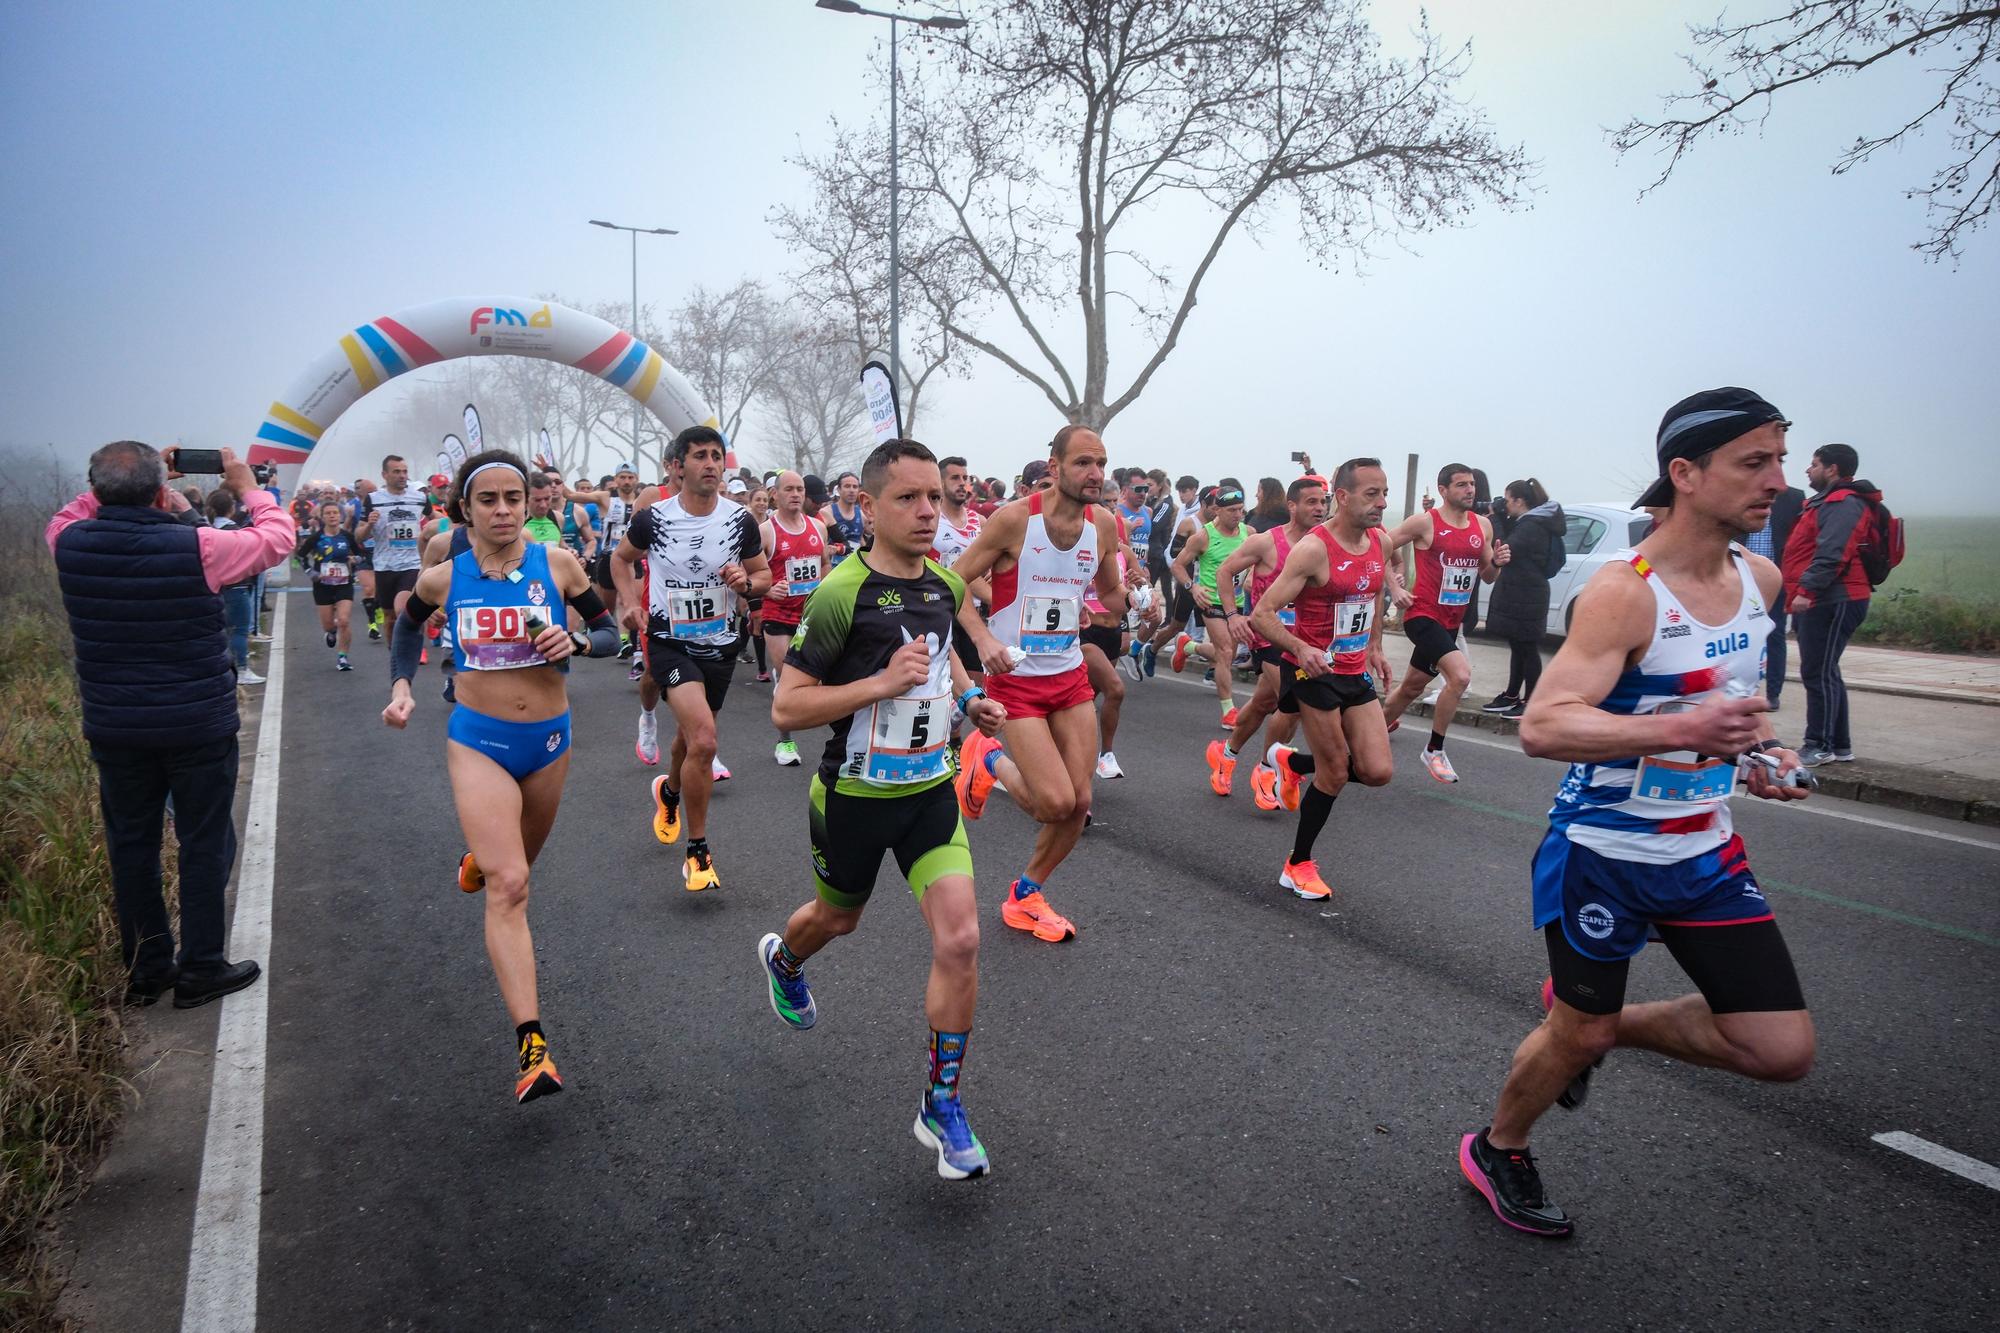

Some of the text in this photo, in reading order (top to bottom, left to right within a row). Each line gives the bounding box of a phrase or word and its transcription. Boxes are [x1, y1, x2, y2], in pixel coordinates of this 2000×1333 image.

[394, 528, 413, 539] 128
[329, 567, 342, 577] 911
[793, 565, 817, 581] 228
[1032, 575, 1048, 583] Club
[1453, 575, 1471, 590] 48
[685, 598, 714, 620] 112
[1046, 608, 1060, 631] 9
[1350, 612, 1368, 633] 51
[1704, 632, 1750, 659] aula
[918, 700, 931, 710] 30
[909, 715, 930, 750] 5
[1583, 915, 1609, 927] CAPEX
